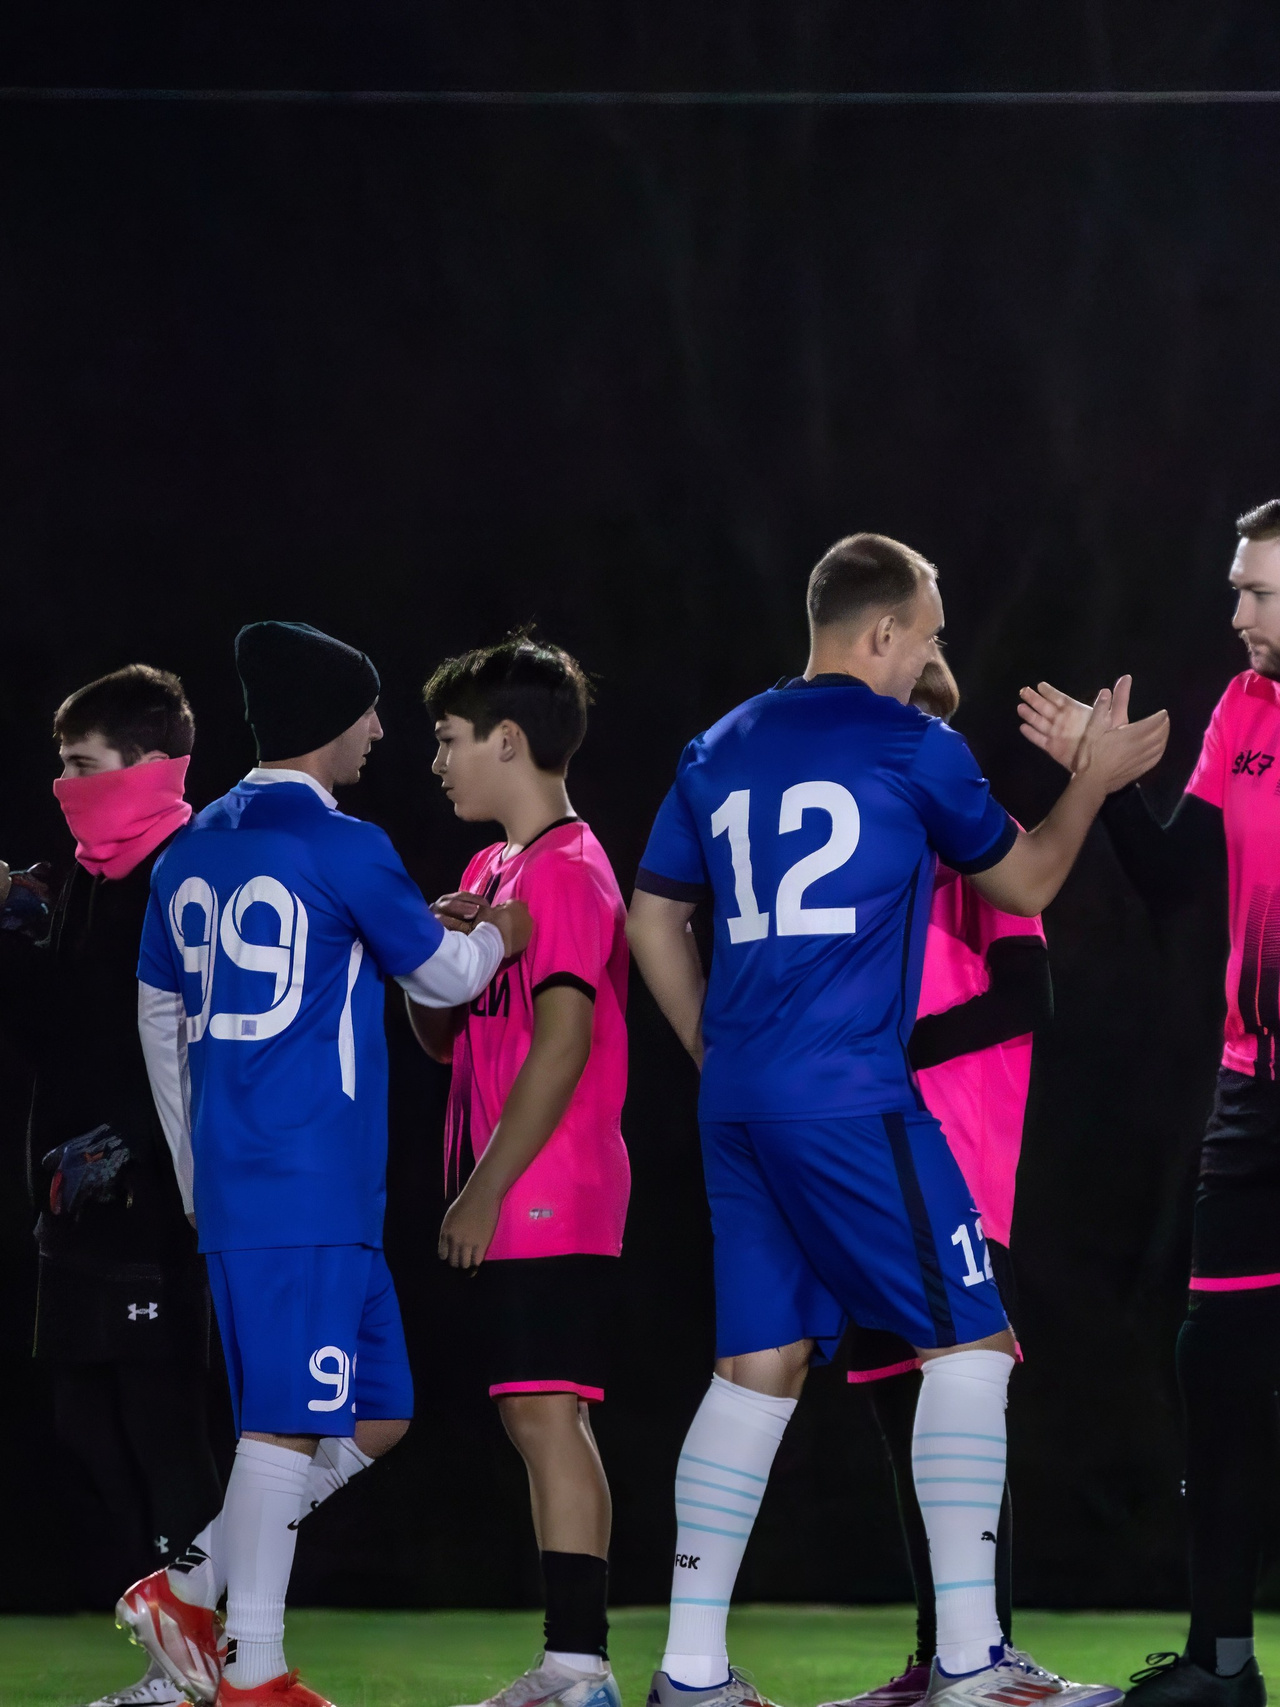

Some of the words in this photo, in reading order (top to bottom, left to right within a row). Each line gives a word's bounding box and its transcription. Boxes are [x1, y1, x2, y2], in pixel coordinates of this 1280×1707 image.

[711, 781, 860, 944] 12
[169, 876, 308, 1041] 99
[308, 1346, 357, 1413] 9
